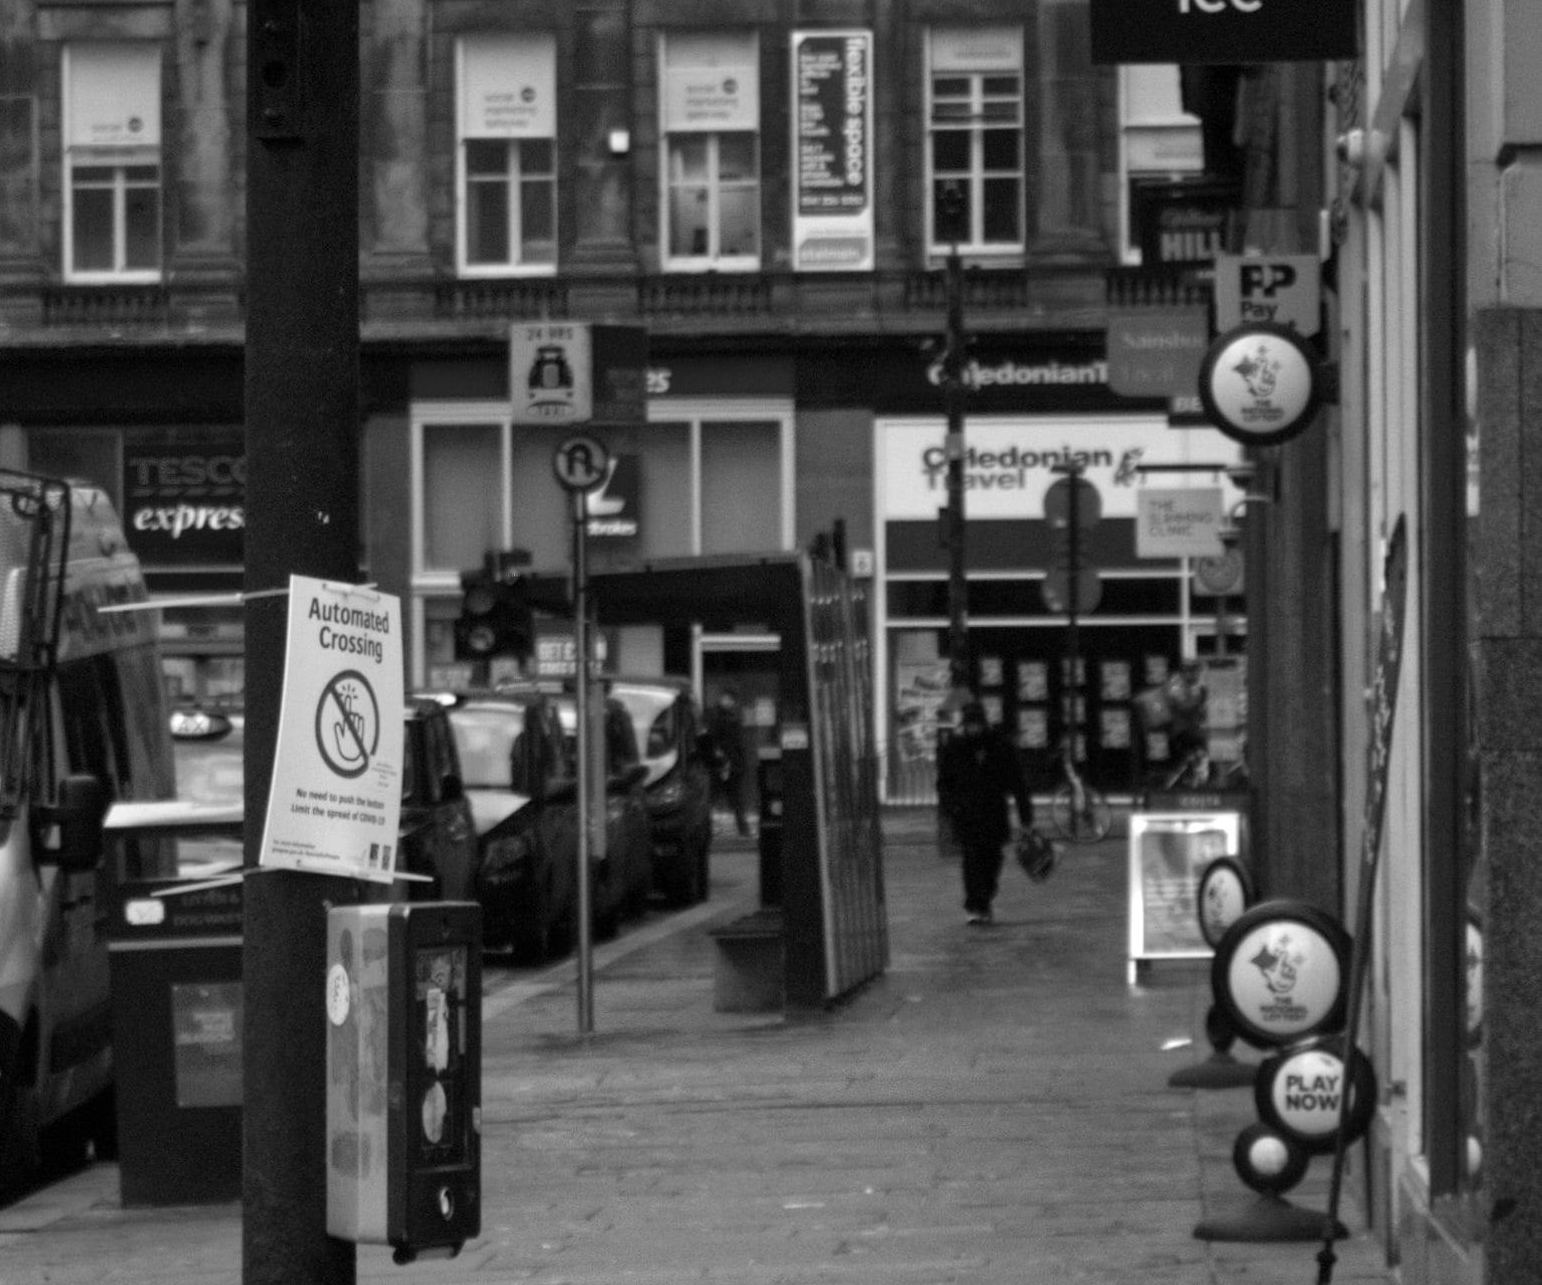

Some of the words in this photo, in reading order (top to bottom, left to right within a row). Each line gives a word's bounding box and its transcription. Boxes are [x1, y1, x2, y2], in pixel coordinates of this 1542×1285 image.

[841, 116, 863, 185] space
[1162, 232, 1221, 261] HILL
[1240, 300, 1279, 324] Pay
[527, 328, 542, 340] 24
[549, 327, 573, 340] HRS
[1122, 332, 1202, 349] Sainsbu
[923, 445, 1113, 470] Cledonian
[923, 469, 1025, 490] Tavel
[133, 503, 245, 539] expres
[308, 597, 389, 634] Automated
[318, 624, 382, 664] Crossing
[296, 788, 308, 799] No
[309, 791, 328, 802] need
[330, 793, 338, 803] to
[338, 795, 355, 807] push
[356, 797, 367, 807] the
[291, 804, 310, 816] Limit
[312, 806, 325, 817] the
[327, 809, 351, 822] spread
[351, 811, 359, 821] of
[1275, 996, 1292, 1005] THE
[1286, 1075, 1339, 1092] PLAY
[1286, 1094, 1340, 1111] NOW
